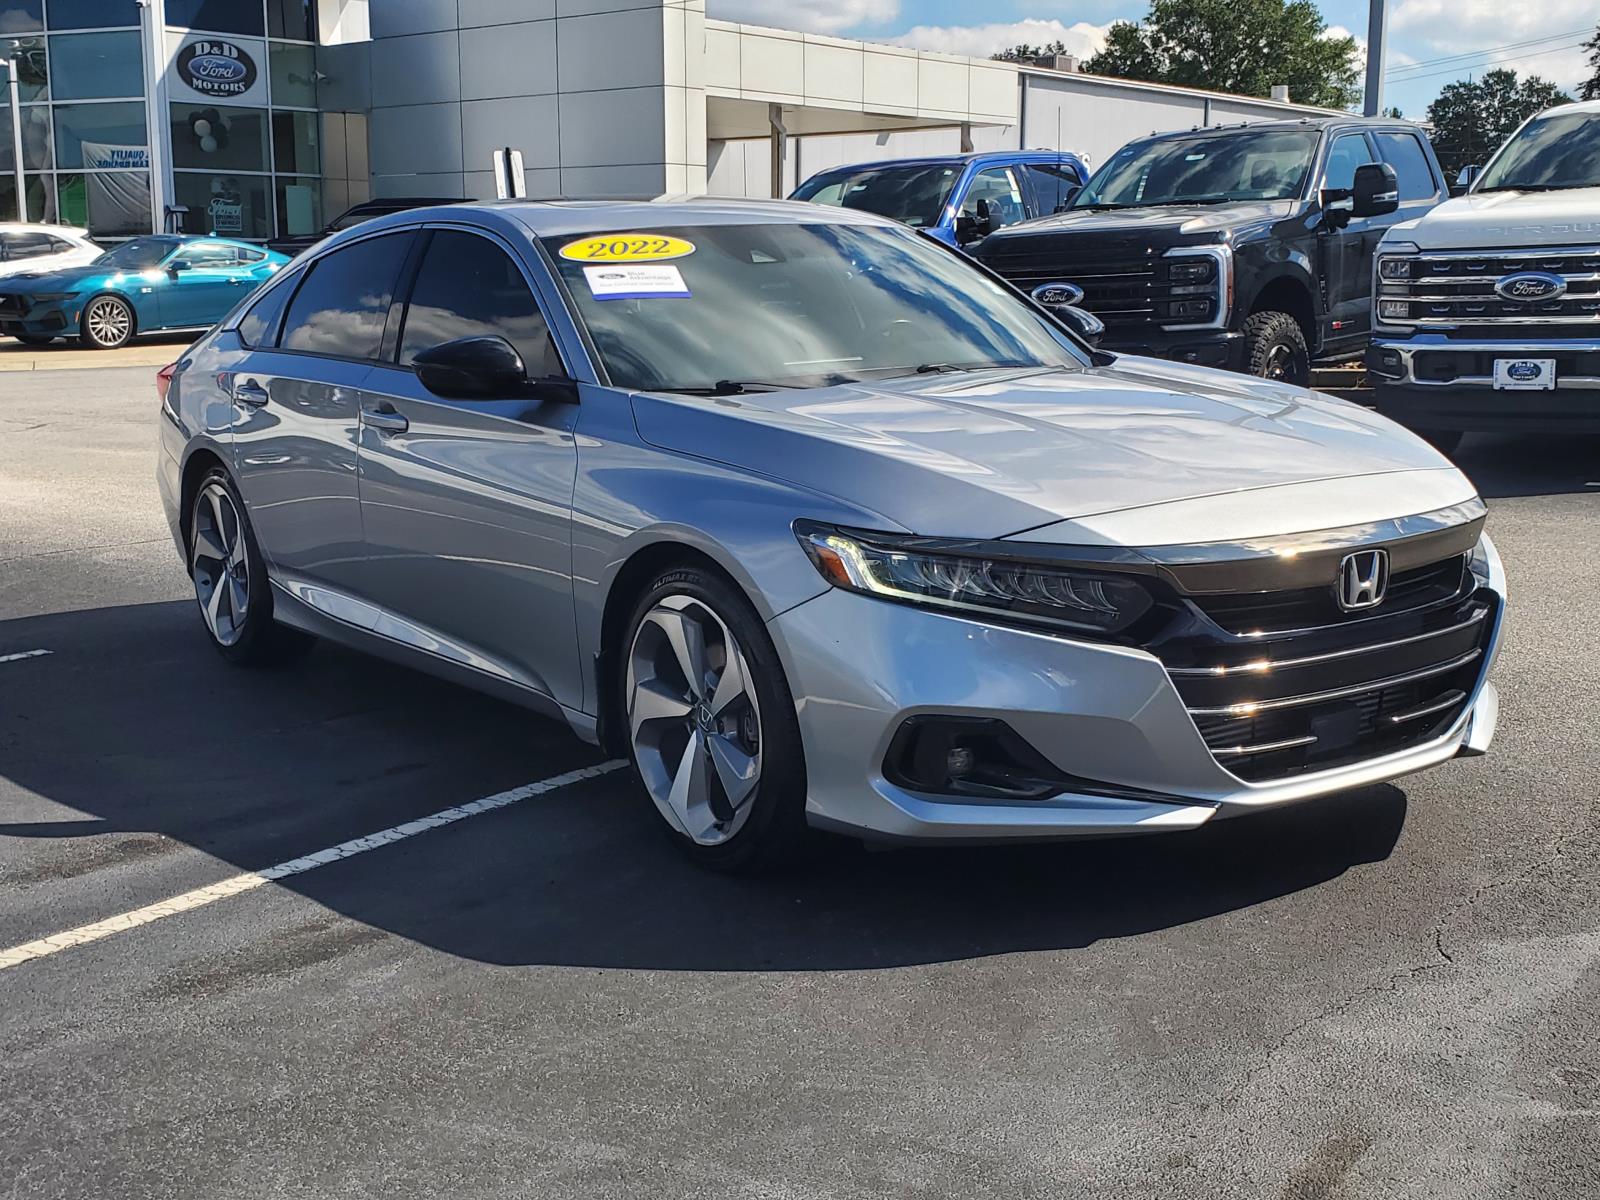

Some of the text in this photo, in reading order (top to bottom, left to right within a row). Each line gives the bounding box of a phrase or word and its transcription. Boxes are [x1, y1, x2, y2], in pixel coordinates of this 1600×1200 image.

[194, 42, 239, 58] D&D
[200, 58, 234, 78] Ford
[192, 78, 246, 92] MOTORS
[587, 239, 670, 258] 2022
[1042, 289, 1068, 302] Ford
[1512, 281, 1545, 295] Ford
